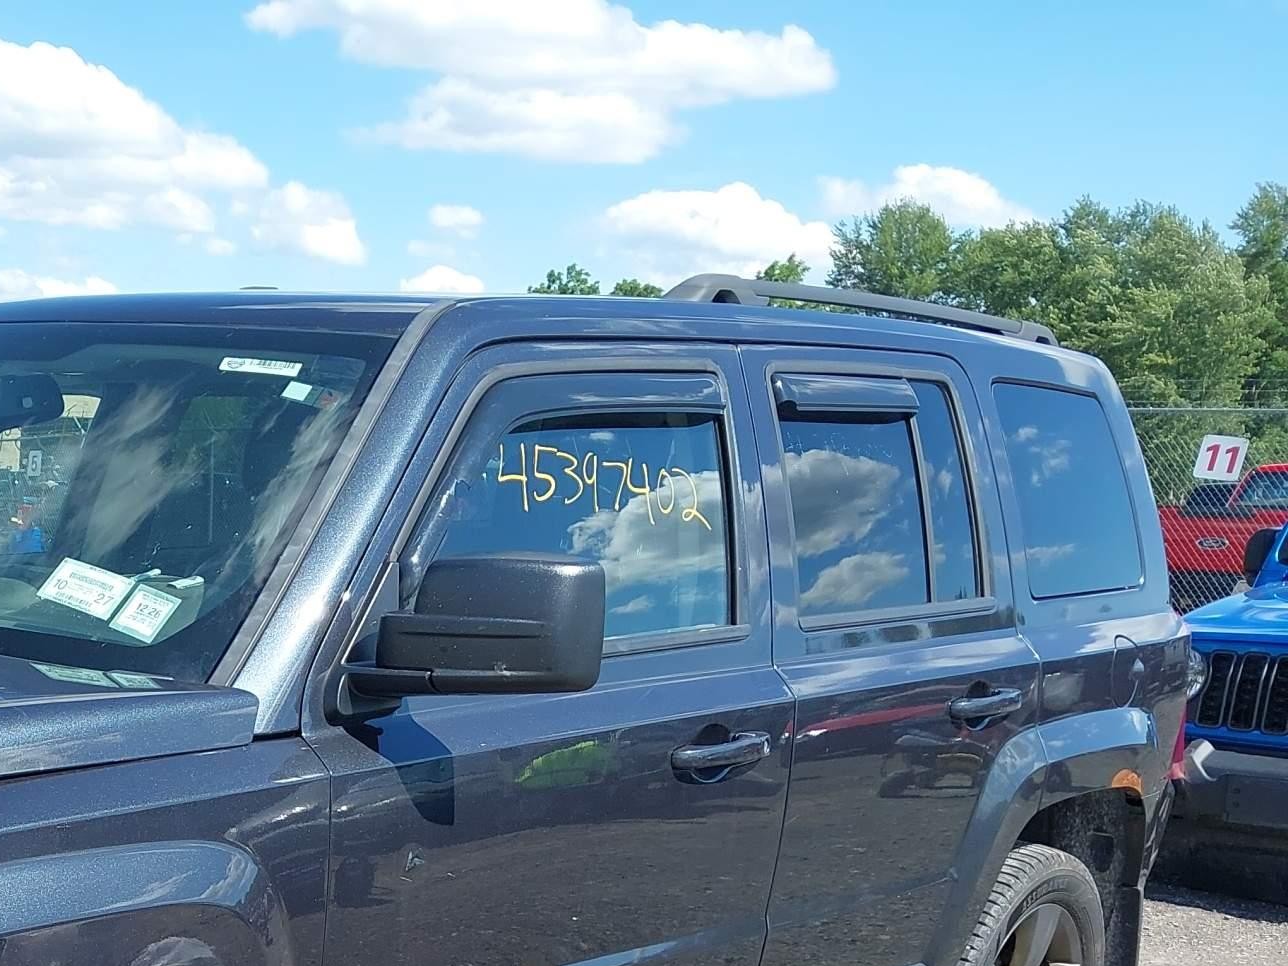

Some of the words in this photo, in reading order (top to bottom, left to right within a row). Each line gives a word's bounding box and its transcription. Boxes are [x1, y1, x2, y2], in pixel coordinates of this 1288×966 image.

[31, 455, 39, 470] 5
[1206, 443, 1241, 474] 11
[497, 442, 713, 531] 45397402
[53, 577, 68, 591] 10
[94, 592, 115, 607] 27
